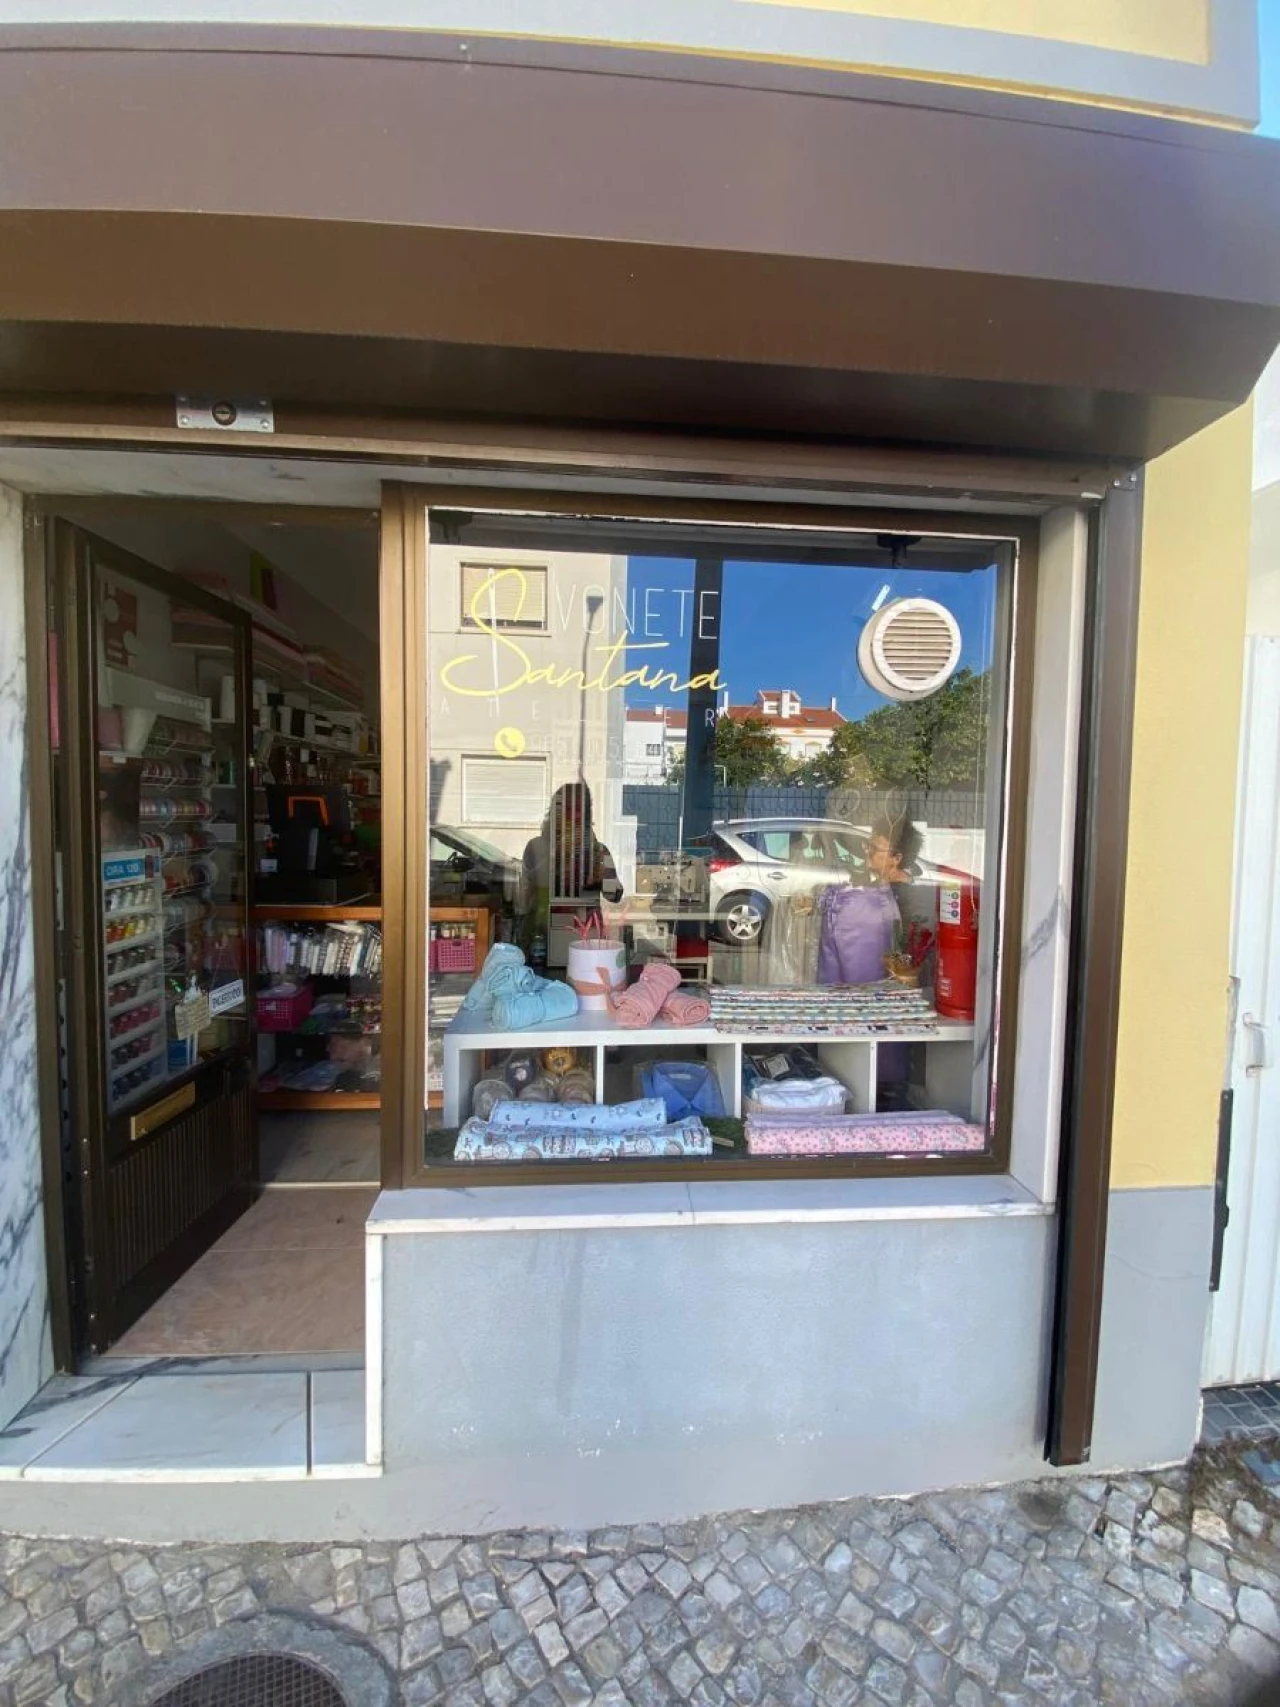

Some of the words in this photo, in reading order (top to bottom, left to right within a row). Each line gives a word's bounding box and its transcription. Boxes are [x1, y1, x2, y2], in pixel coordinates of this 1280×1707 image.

[440, 568, 728, 697] Santana
[540, 582, 719, 640] IVONETE
[440, 696, 715, 727] ATEER
